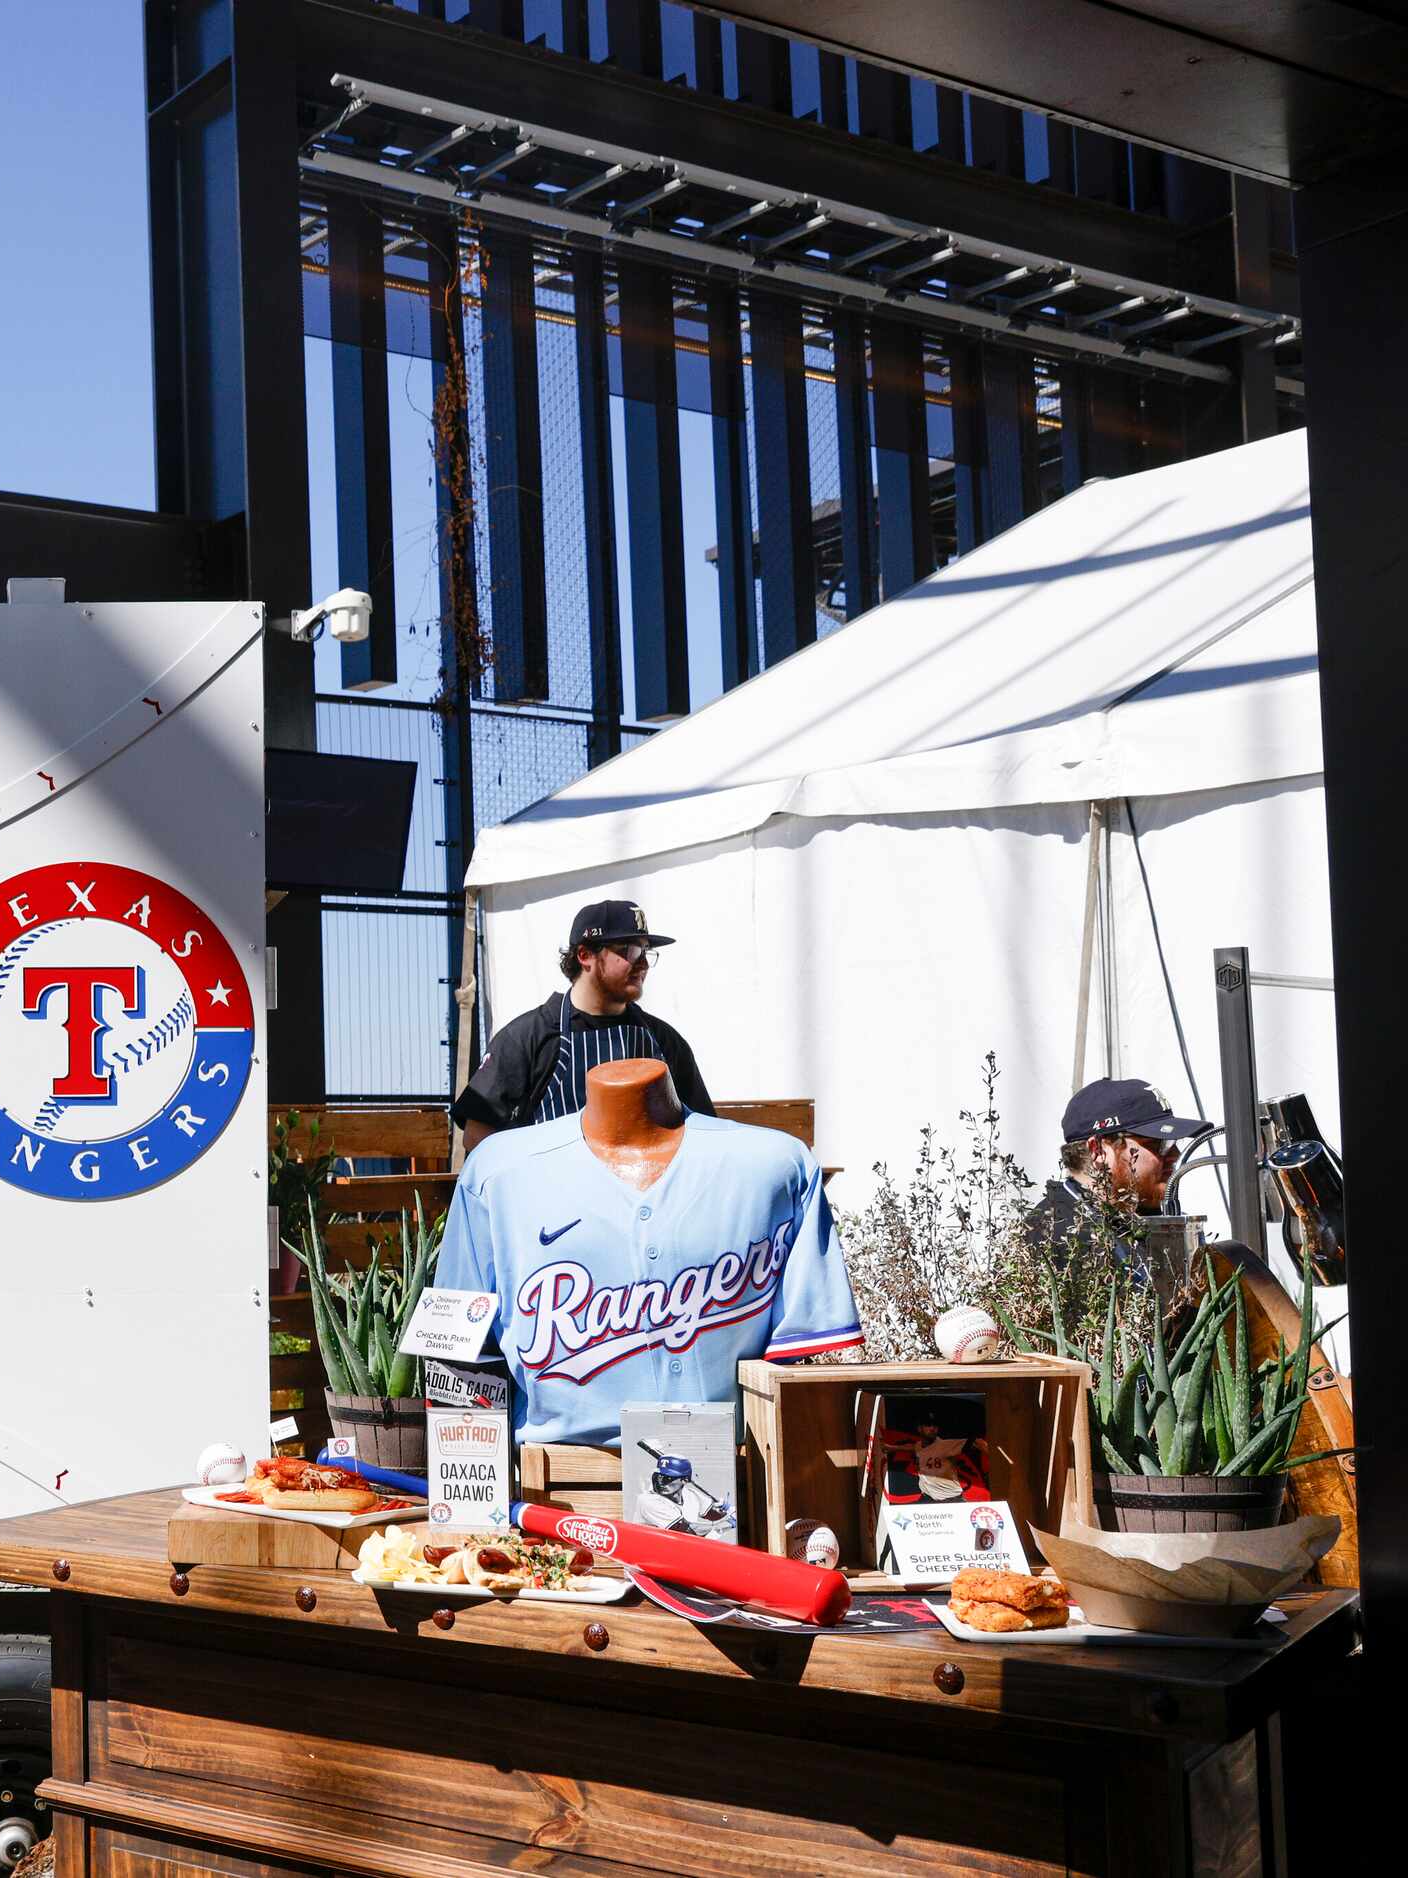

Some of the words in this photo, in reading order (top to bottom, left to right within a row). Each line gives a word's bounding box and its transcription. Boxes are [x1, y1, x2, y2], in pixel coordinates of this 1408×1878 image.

[21, 964, 146, 1106] T
[516, 1219, 792, 1374] Rangers
[415, 1330, 448, 1341] CHICKEN
[450, 1334, 471, 1343] PARM
[425, 1371, 463, 1394] ADOLIS
[466, 1381, 506, 1403] GARCÍA
[439, 1426, 497, 1443] HURTADO
[440, 1463, 496, 1480] OAXACA
[443, 1484, 494, 1502] DAAWG
[562, 1522, 612, 1549] Slugger
[910, 1554, 951, 1563] SUPER
[954, 1552, 1011, 1562] SLUGGER
[916, 1564, 962, 1573] CHEESE
